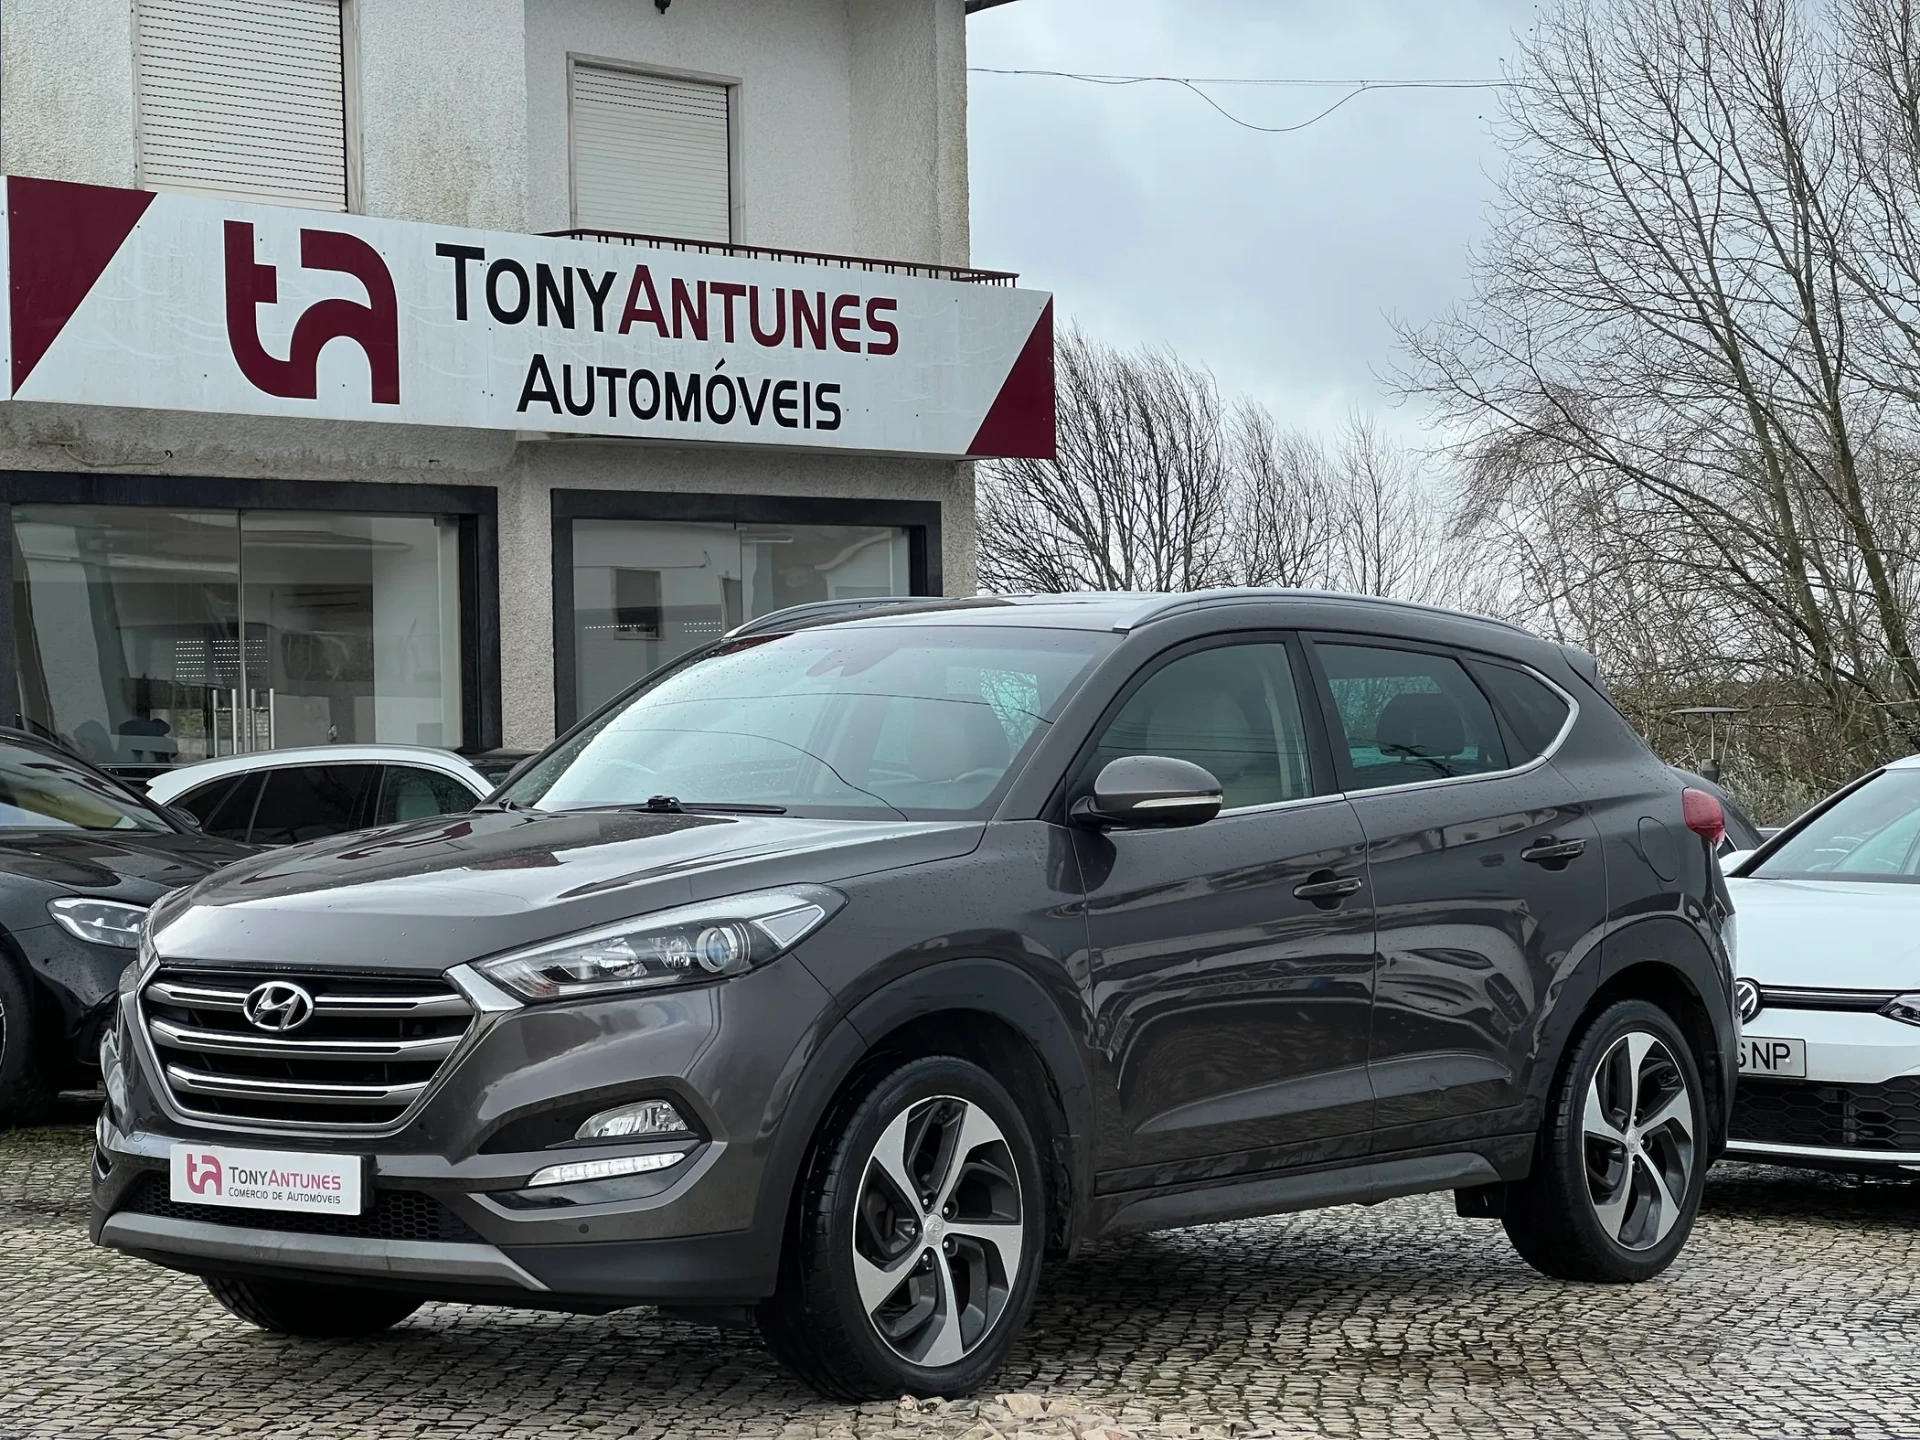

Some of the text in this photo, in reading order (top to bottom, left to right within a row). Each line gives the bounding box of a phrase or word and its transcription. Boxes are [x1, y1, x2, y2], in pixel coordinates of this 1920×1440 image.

[517, 354, 841, 431] AUTOMÓVEIS
[272, 1192, 283, 1200] DE
[287, 1191, 341, 1204] AUTOMÓVEIS
